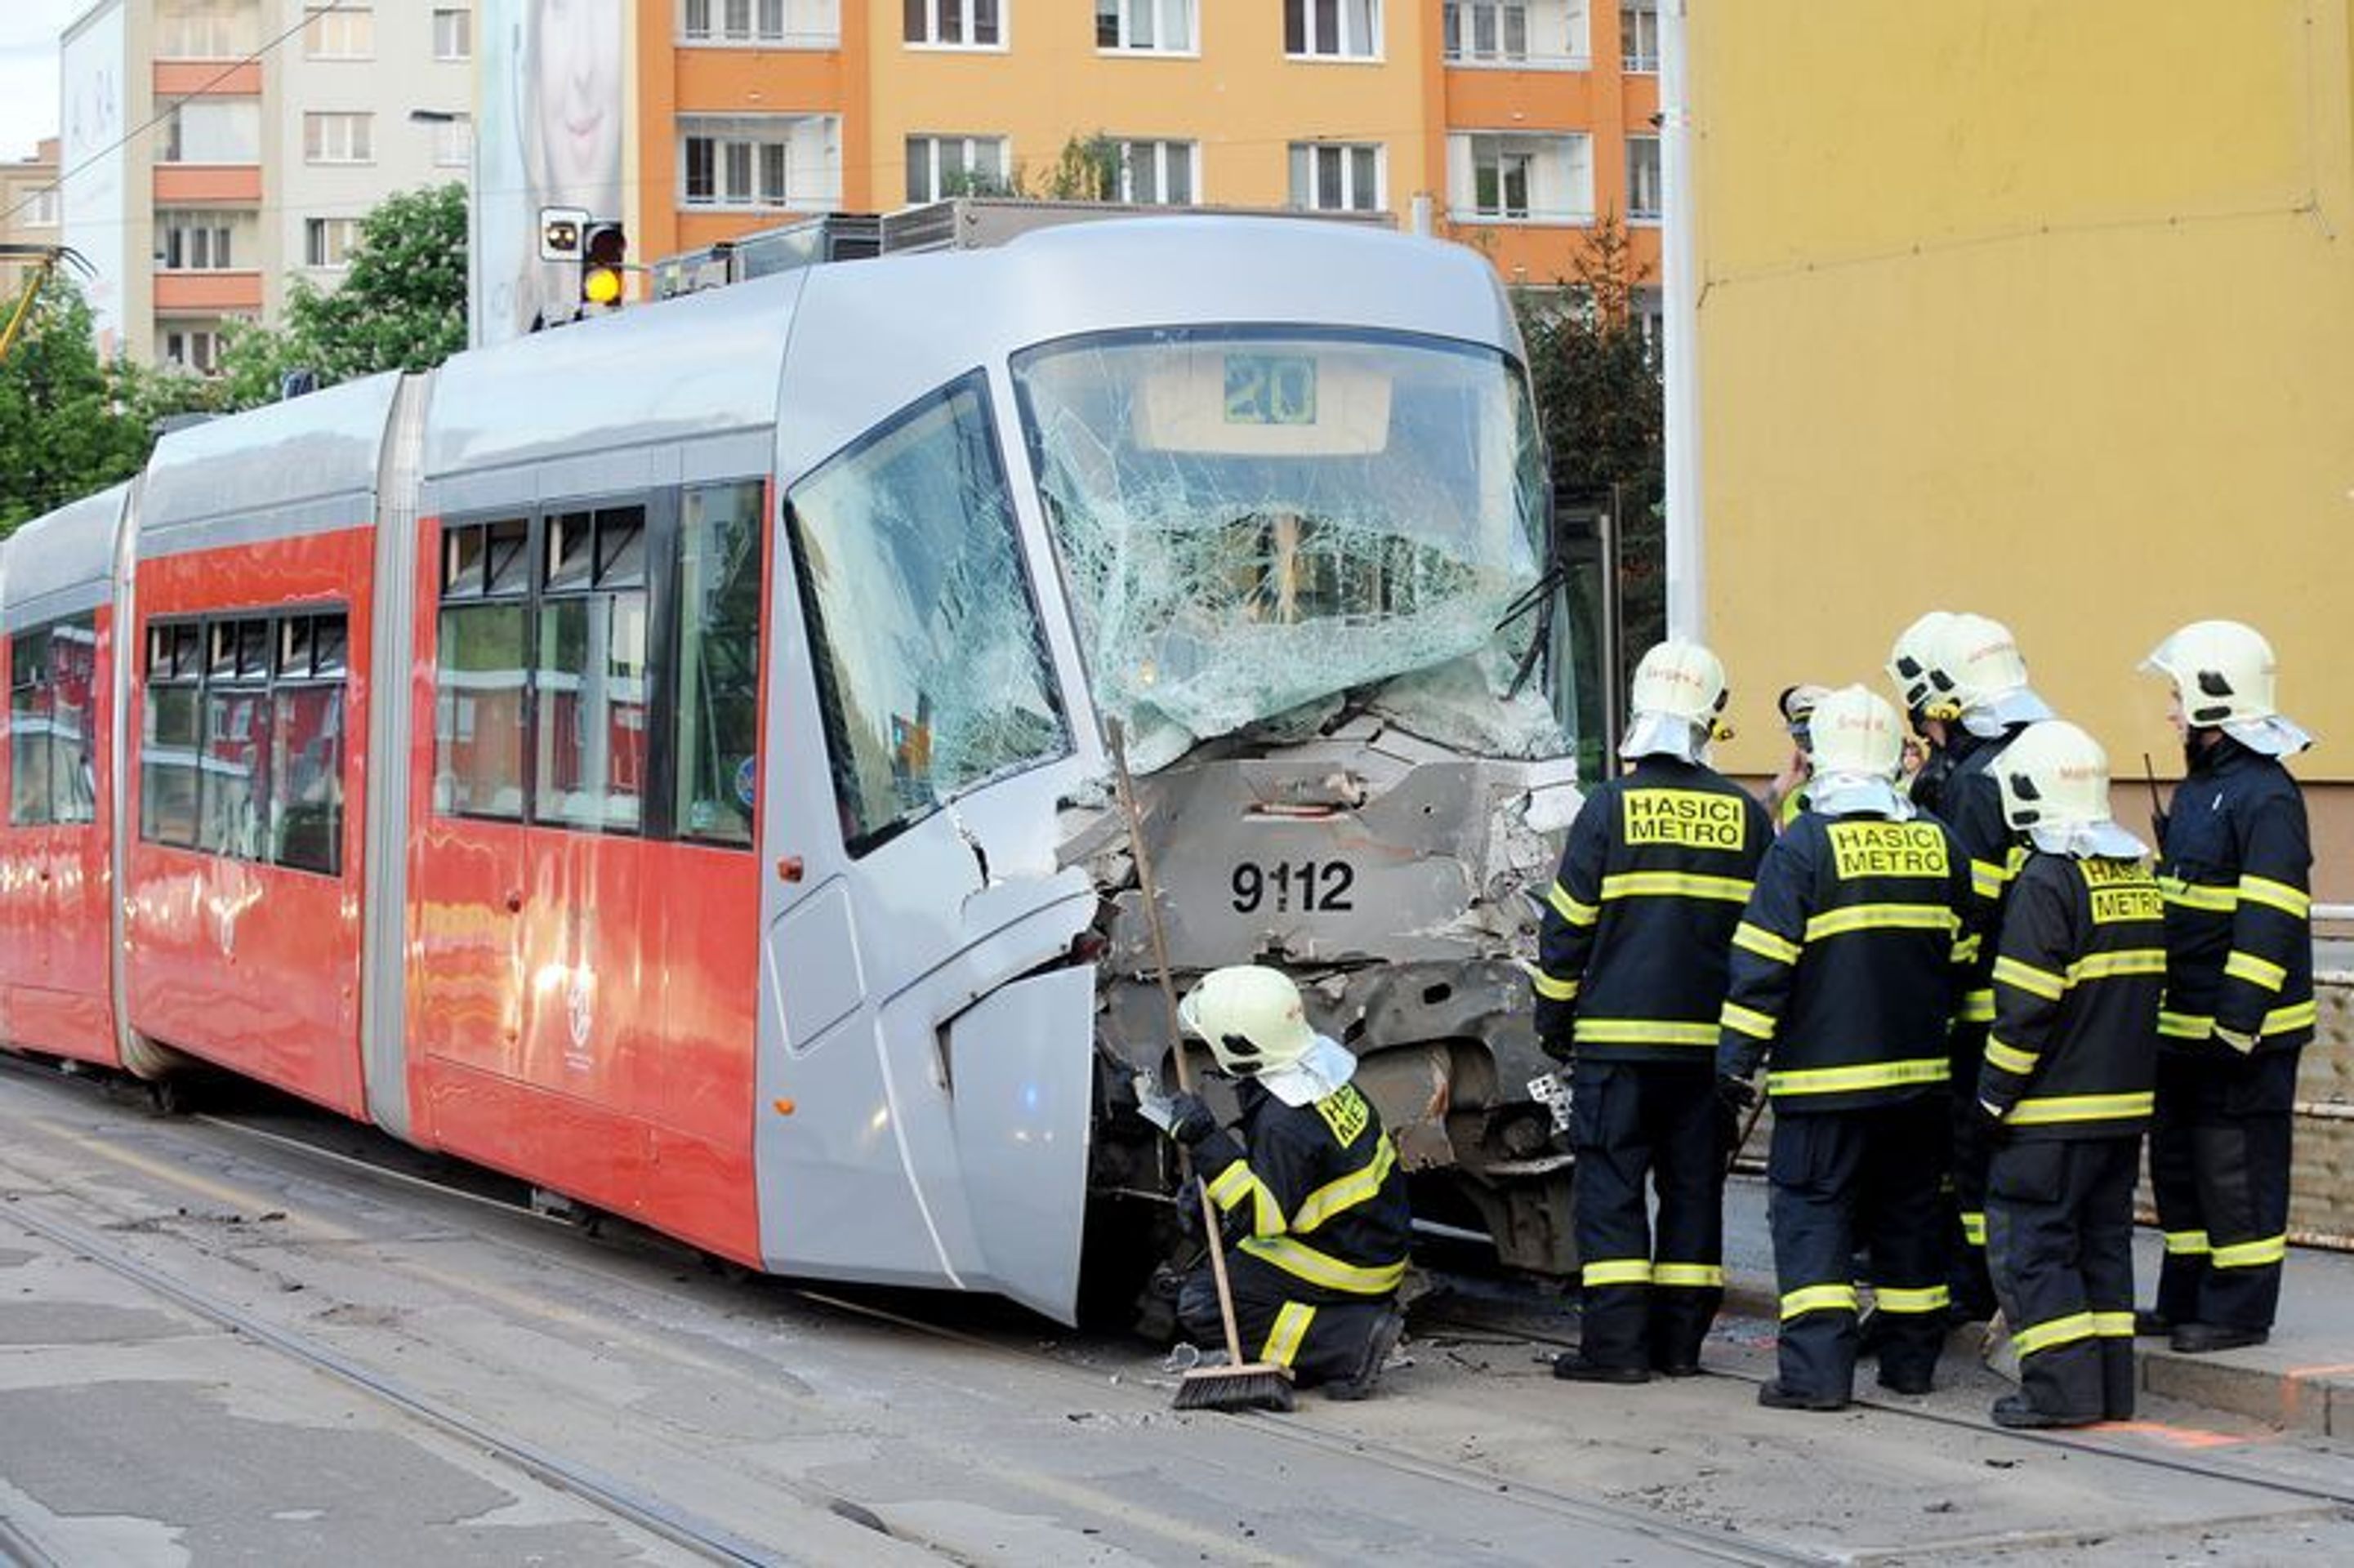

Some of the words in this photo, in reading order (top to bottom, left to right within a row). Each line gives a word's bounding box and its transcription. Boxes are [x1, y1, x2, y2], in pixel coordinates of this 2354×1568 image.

[1225, 359, 1313, 423] 20
[1631, 818, 1739, 845] METRO
[1842, 850, 1944, 873] METRO
[1232, 861, 1355, 914] 9112
